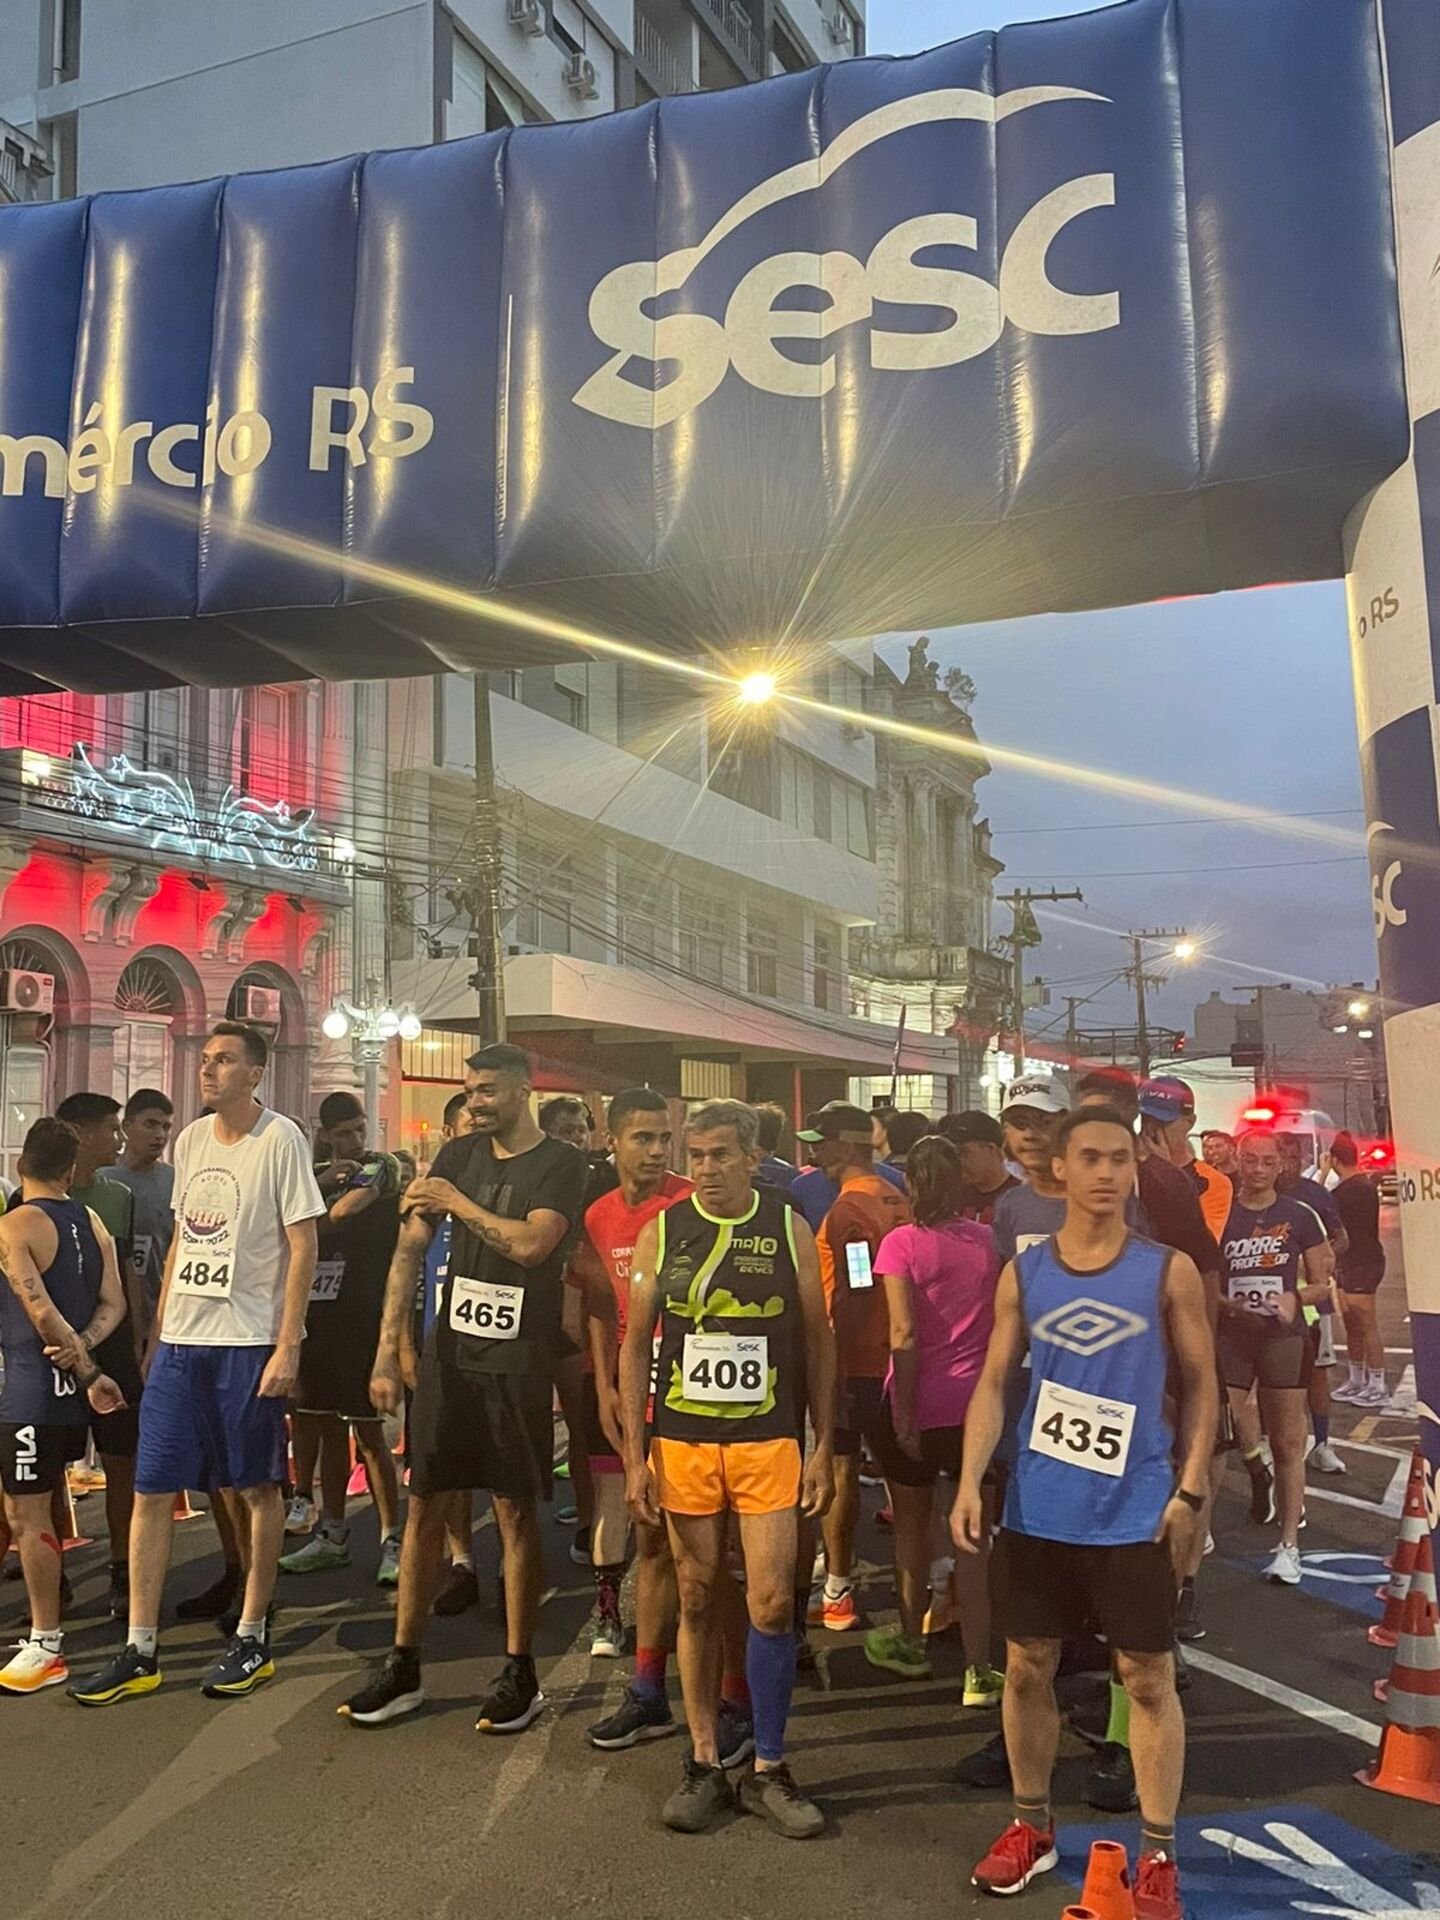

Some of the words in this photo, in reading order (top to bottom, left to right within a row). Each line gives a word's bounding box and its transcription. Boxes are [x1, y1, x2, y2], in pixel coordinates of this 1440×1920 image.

[309, 366, 434, 472] RS
[1370, 586, 1400, 629] RS
[1223, 1236, 1284, 1259] CORRE
[178, 1260, 230, 1288] 484
[455, 1298, 515, 1331] 465
[736, 1341, 761, 1352] Sesc
[689, 1358, 762, 1390] 408
[1040, 1411, 1123, 1461] 435
[15, 1424, 39, 1481] FILA
[241, 1652, 264, 1674] FILA
